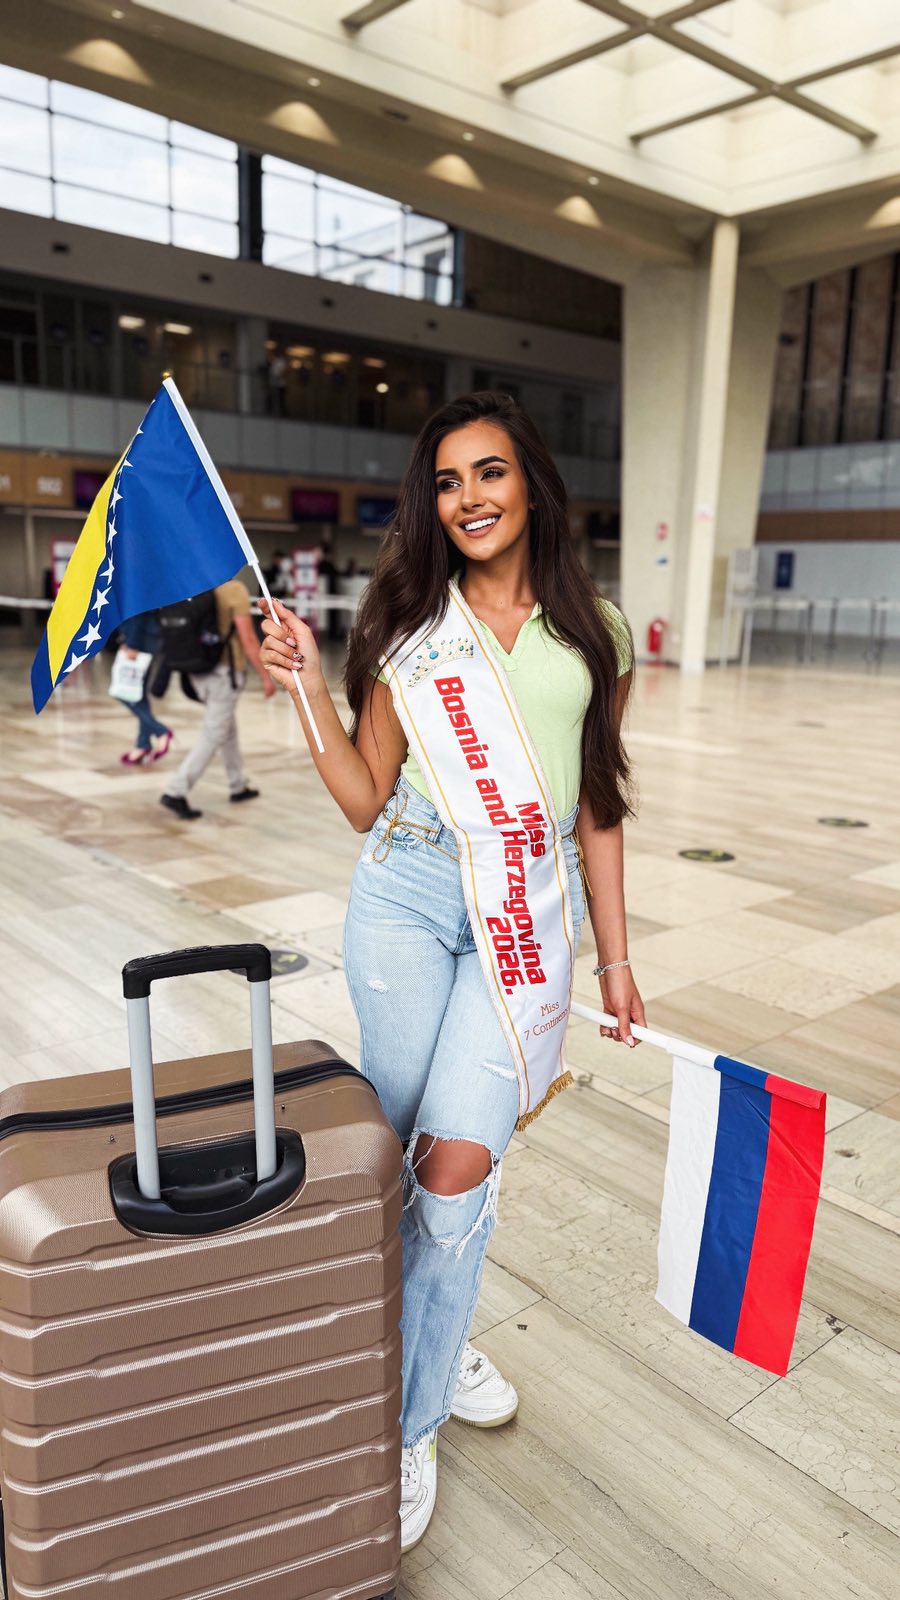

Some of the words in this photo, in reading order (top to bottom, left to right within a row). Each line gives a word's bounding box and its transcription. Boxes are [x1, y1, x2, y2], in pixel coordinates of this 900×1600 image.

[433, 676, 489, 770] Bosnia
[475, 778, 518, 826] and
[500, 830, 547, 984] Herzegovina
[515, 801, 548, 857] Miss
[486, 916, 525, 995] 2026.
[523, 1029, 530, 1041] 7
[540, 1001, 560, 1017] Miss
